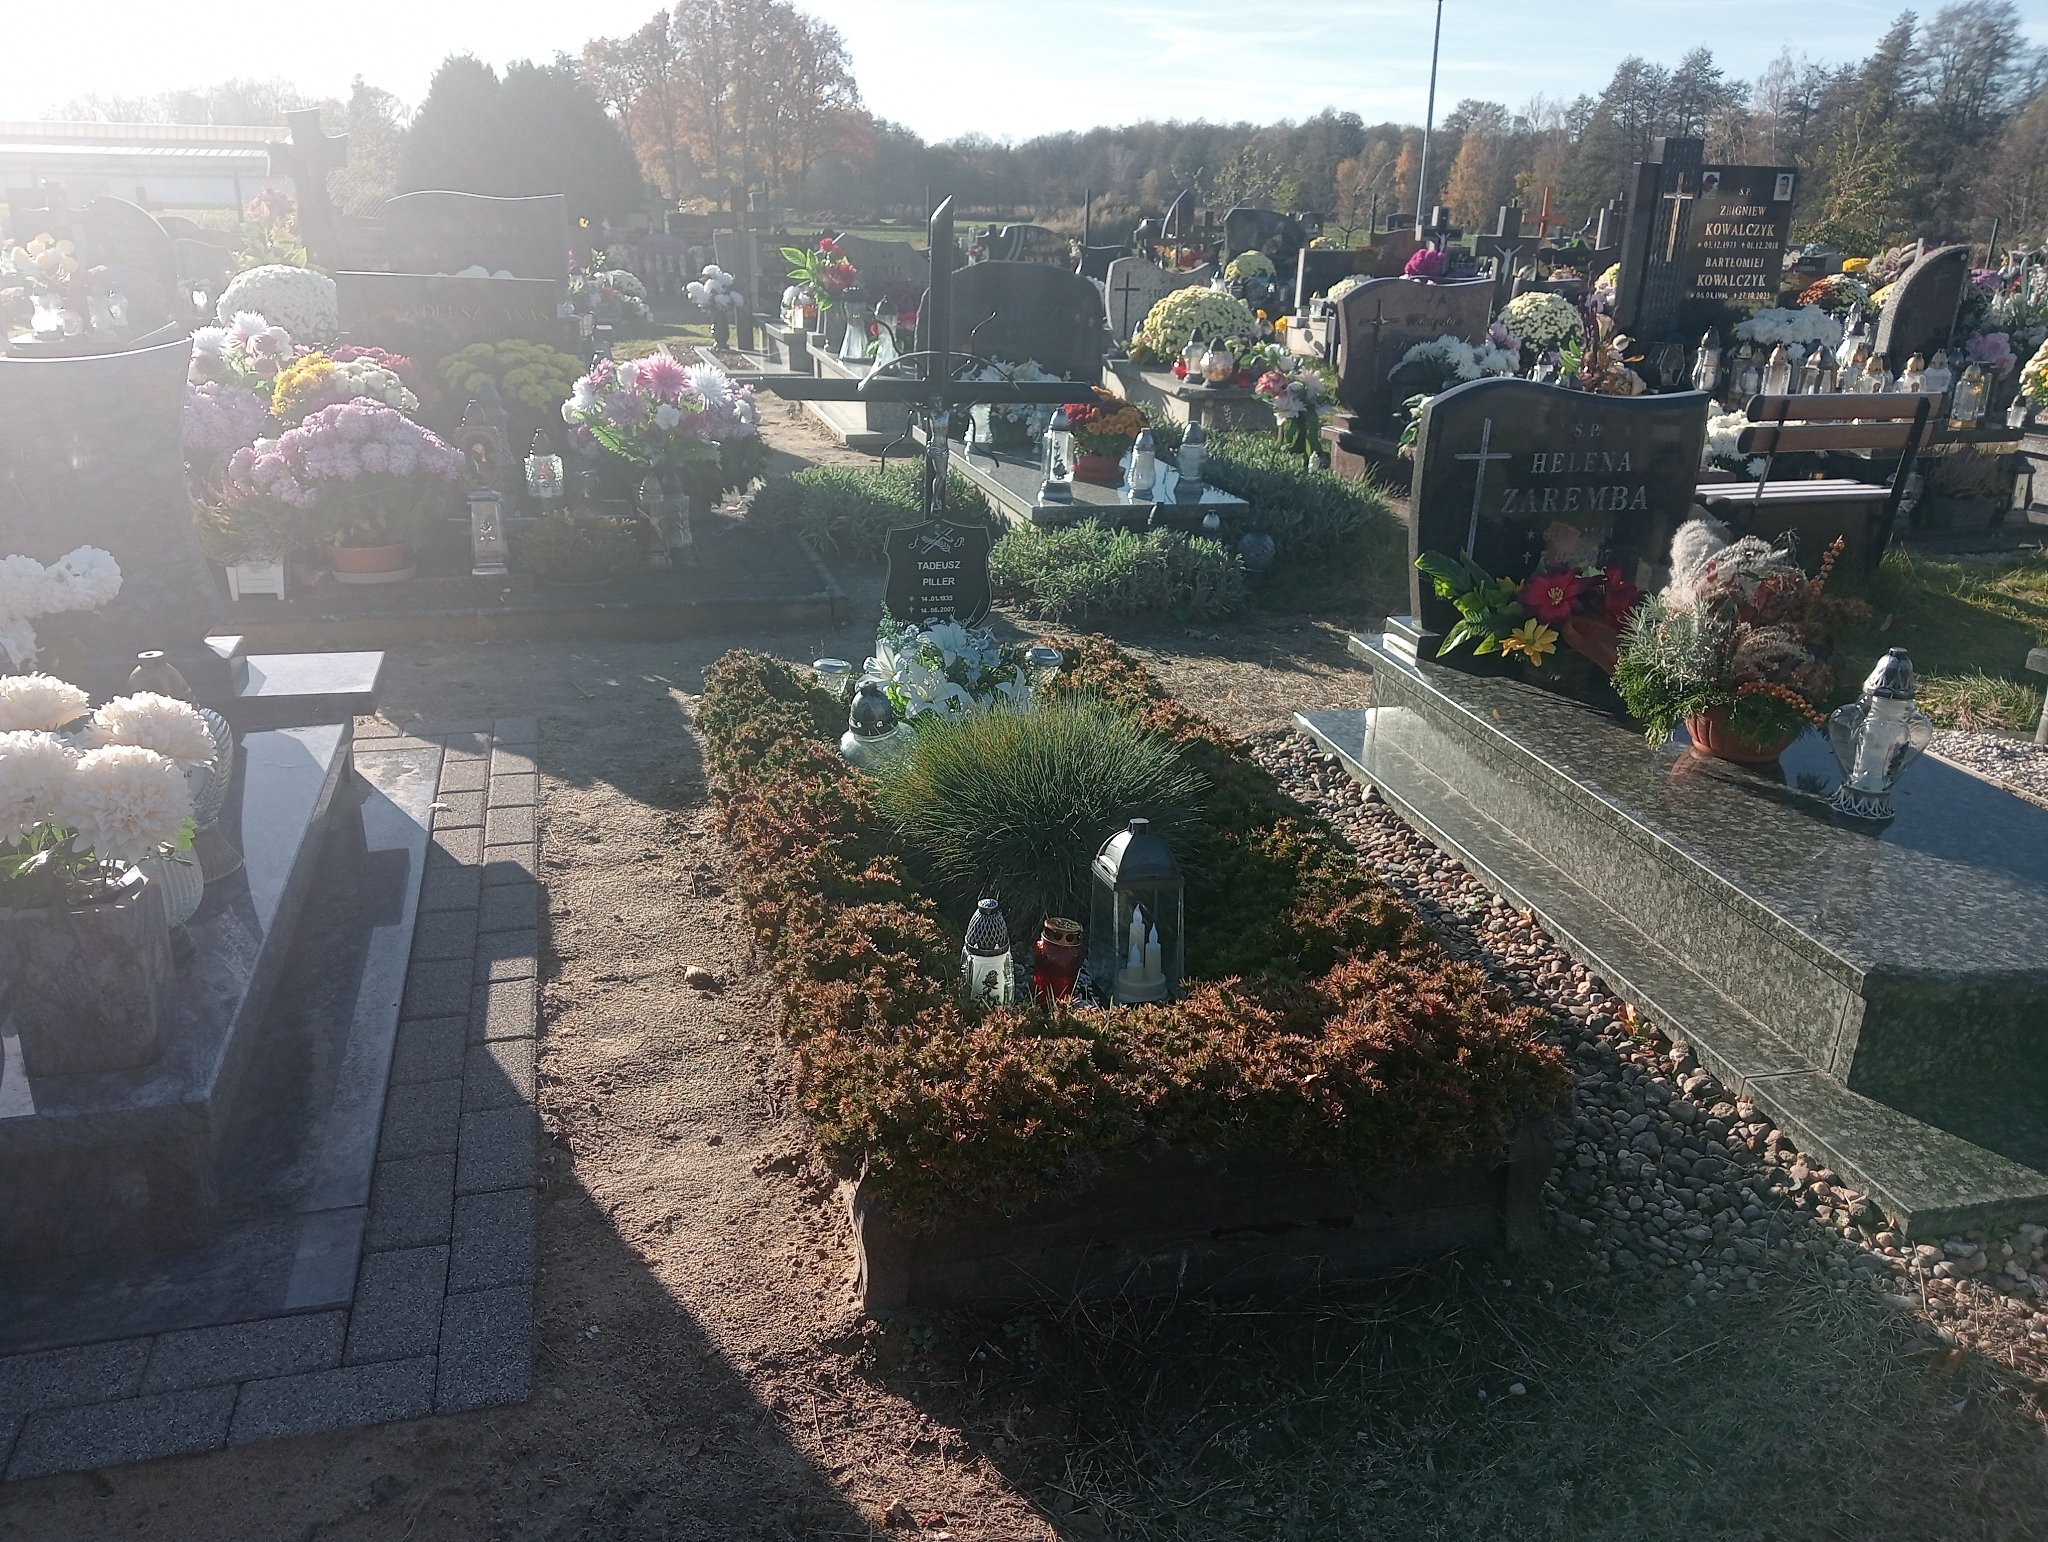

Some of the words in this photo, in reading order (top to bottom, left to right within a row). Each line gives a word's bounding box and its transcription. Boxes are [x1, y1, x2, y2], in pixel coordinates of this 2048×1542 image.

[1719, 205, 1766, 216] ZBIGNIEW
[1705, 223, 1775, 237] KOWALCZYK
[1705, 257, 1764, 268] BARTŁOMIEJ
[1697, 274, 1766, 287] KOWALCZYK
[1531, 452, 1632, 474] HELENA
[1502, 486, 1648, 513] ZAREMBA
[917, 560, 961, 570] TADEUSZ
[922, 577, 956, 586] PILLER
